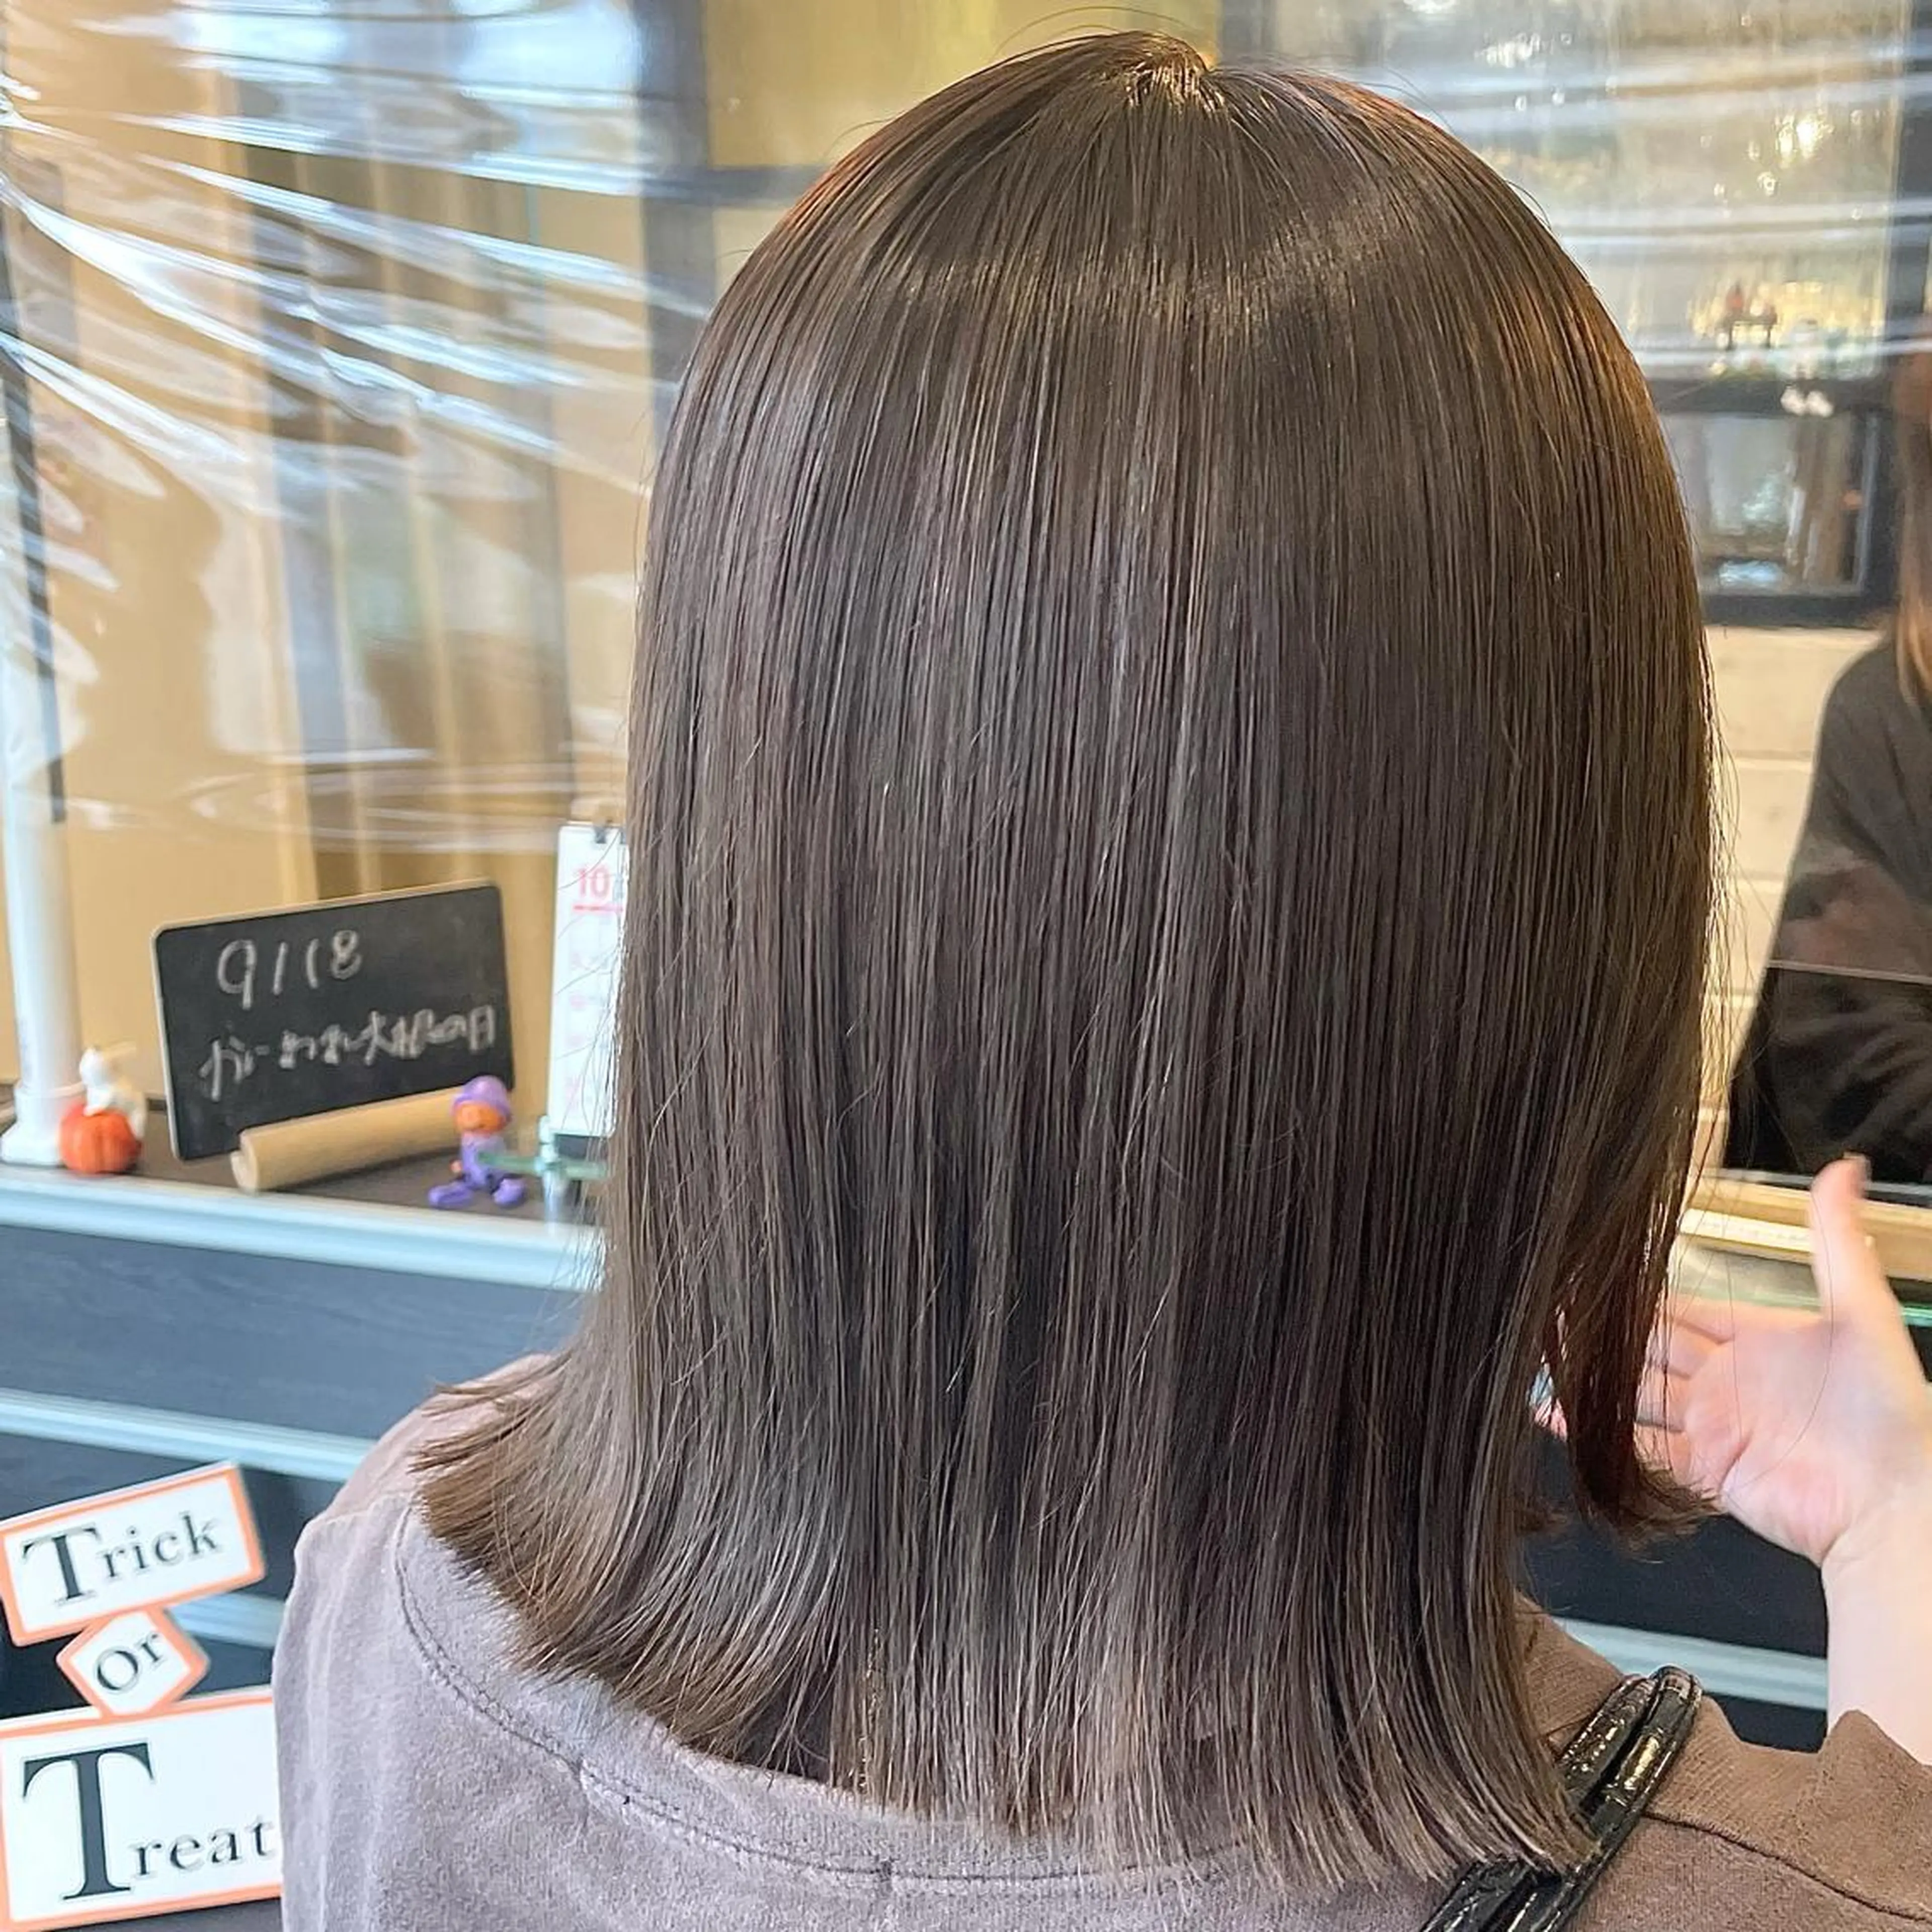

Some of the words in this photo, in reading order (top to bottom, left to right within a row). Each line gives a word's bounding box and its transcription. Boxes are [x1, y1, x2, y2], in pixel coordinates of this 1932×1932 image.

[575, 866, 611, 899] 10
[22, 1511, 218, 1605] Trick
[94, 1631, 166, 1693] Or
[22, 1740, 274, 1900] Treat
